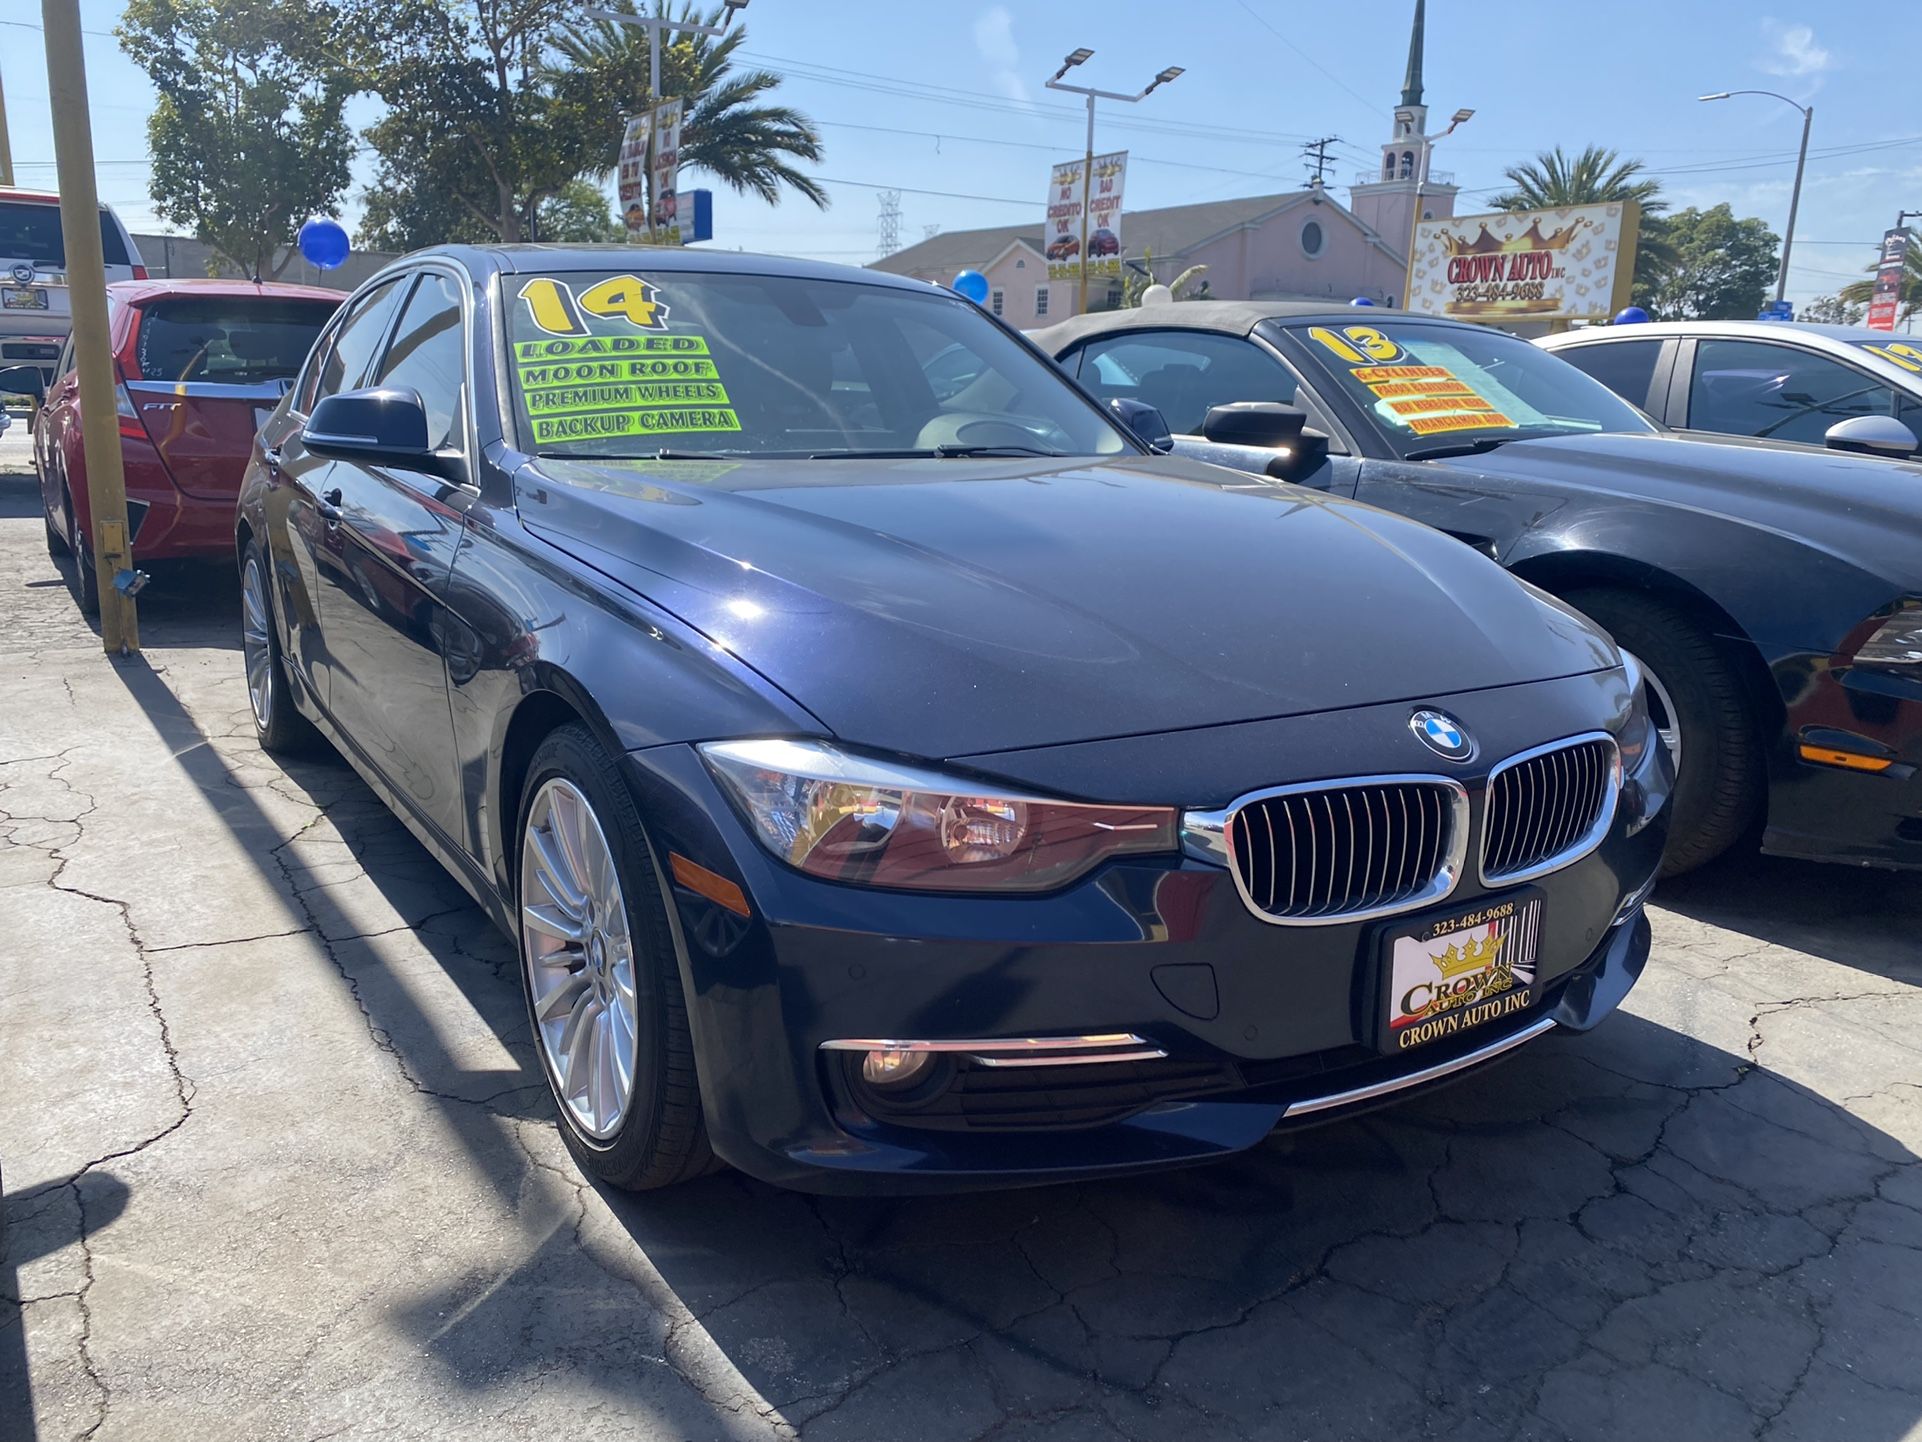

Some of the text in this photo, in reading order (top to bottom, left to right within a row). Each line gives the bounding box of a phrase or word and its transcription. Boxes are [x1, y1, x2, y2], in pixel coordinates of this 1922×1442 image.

[1057, 219, 1069, 233] OK
[1097, 213, 1109, 228] OK
[1447, 254, 1507, 284] CROWN
[1507, 250, 1553, 281] AUTO
[518, 274, 671, 337] 14
[1456, 281, 1545, 303] 323-484-9688
[521, 337, 701, 358] LOADED
[1308, 326, 1410, 365] 13
[524, 360, 714, 386] MOON ROOF
[1356, 367, 1450, 380] 6-CYLINDER
[531, 384, 721, 410] PREMIUM WHEELS
[538, 410, 734, 439] BACKUP CAMERA
[1414, 711, 1451, 727] BMW
[1433, 903, 1514, 936] 323-484-9688
[1401, 962, 1514, 1016] CROWN
[1424, 977, 1513, 1017] AUTO INC
[1400, 989, 1530, 1048] CROWN AUTO INC
